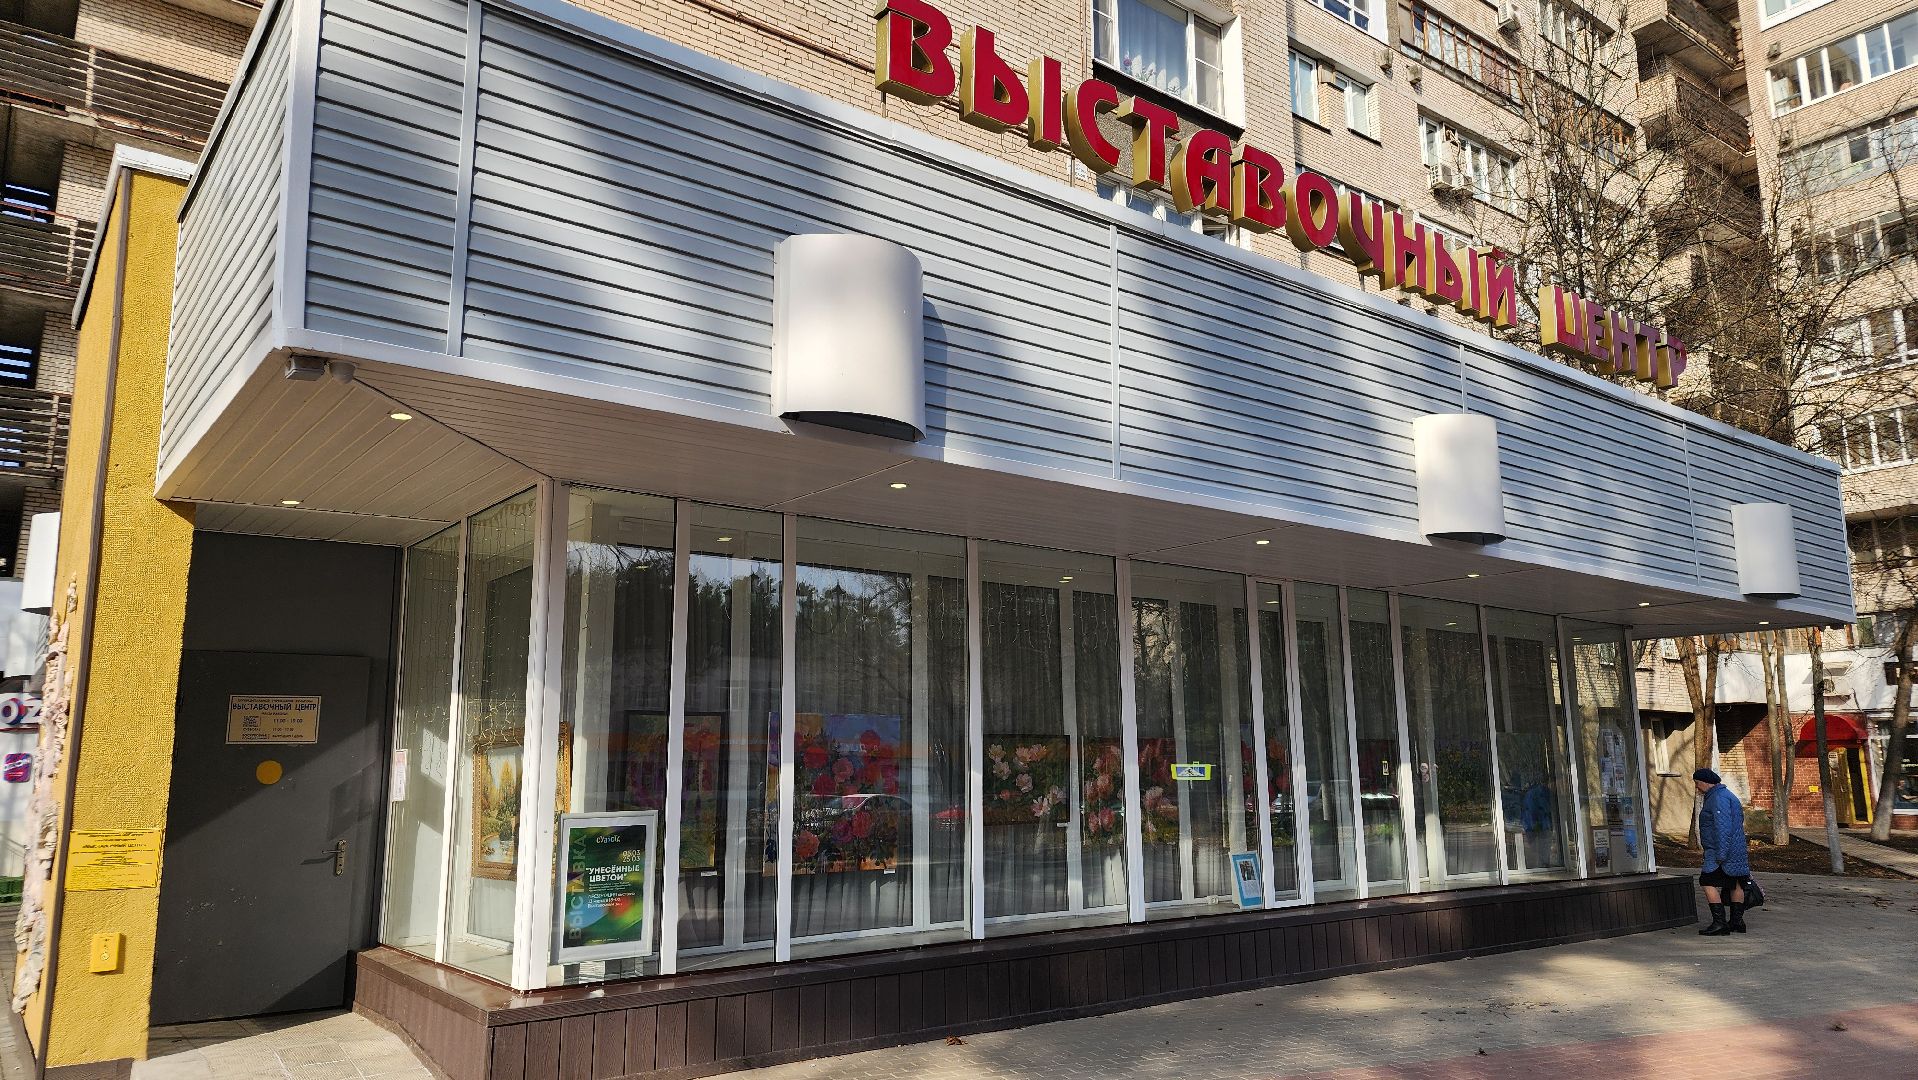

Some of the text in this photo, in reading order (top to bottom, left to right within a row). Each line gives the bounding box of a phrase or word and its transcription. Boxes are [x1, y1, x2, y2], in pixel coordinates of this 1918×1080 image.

[876, 0, 1688, 389] ВЫСТАВОЧНЫЙ ЦЕНТР
[232, 703, 317, 711] ВЫСТАВОЧНЫЙ ЦЕНТР
[569, 835, 586, 939] ВЫСТАВКА
